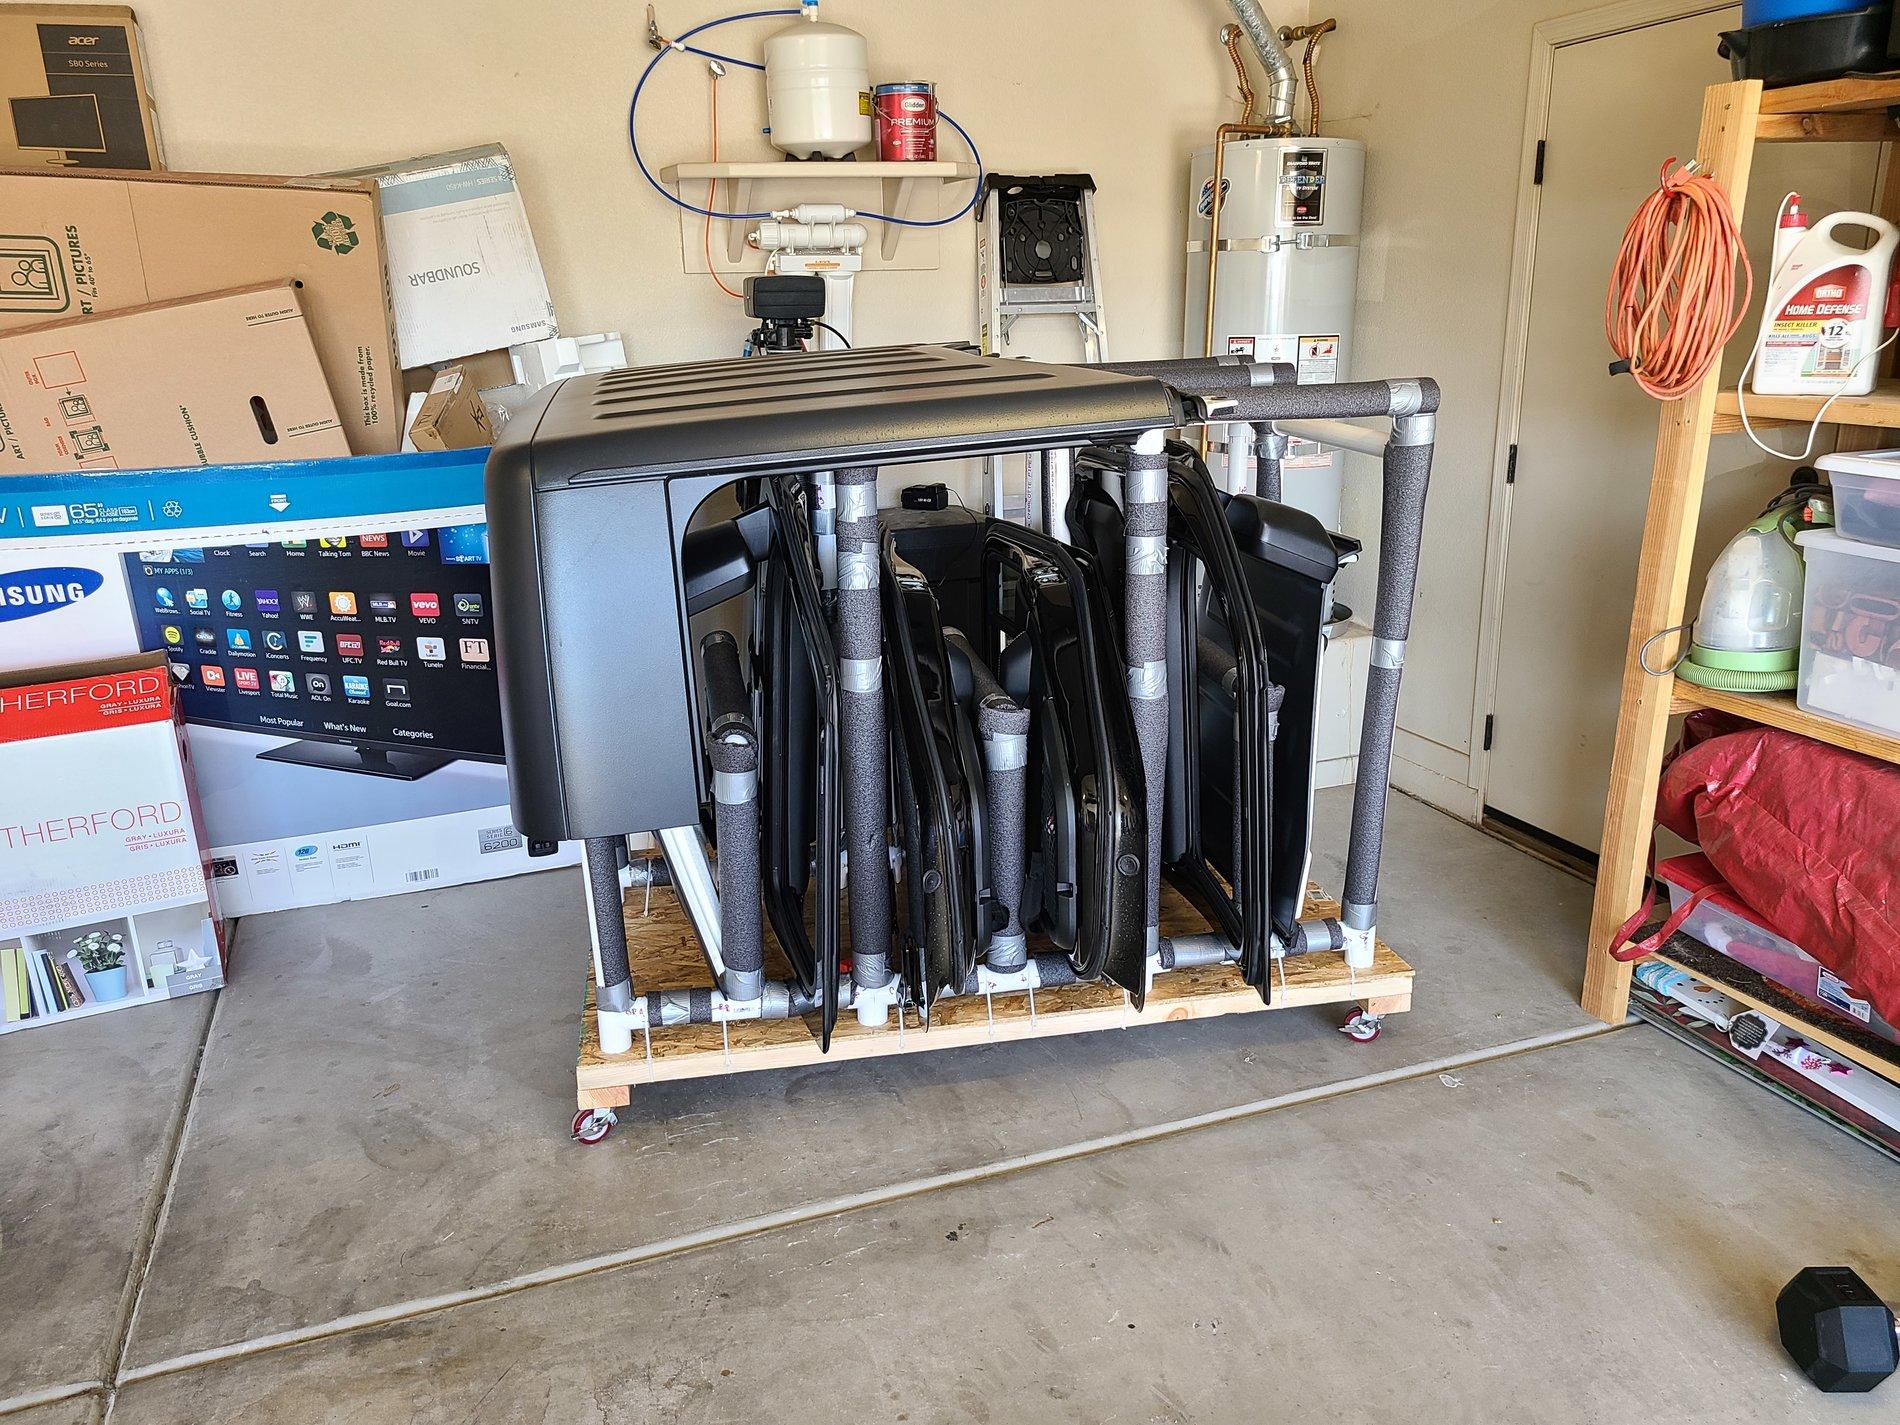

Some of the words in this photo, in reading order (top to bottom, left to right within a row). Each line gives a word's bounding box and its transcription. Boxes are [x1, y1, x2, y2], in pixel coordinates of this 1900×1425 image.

[68, 36, 99, 46] acer
[85, 60, 108, 68] Series
[890, 118, 935, 126] PREMIUM
[1280, 175, 1326, 184] DEFENDER
[65, 224, 88, 285] PICTURES
[408, 261, 481, 288] SOUNDBAR
[80, 300, 94, 314] RT
[1784, 304, 1815, 316] HOME
[1816, 304, 1863, 315] DEFENSE
[511, 320, 547, 334] SAMSUNG
[1829, 326, 1844, 336] 12
[365, 346, 374, 371] paper.
[366, 371, 376, 402] recycled
[11, 444, 26, 460] ART
[70, 503, 103, 518] 65"
[361, 533, 386, 541] NEWS
[180, 568, 194, 576] (1/3)
[412, 601, 438, 610] vevo
[464, 640, 486, 654] FT
[300, 655, 328, 663] Frequency
[100, 701, 123, 709] GRAY
[128, 696, 161, 705] LUXURA
[129, 703, 162, 711] LUXURA
[277, 717, 304, 727] Popular
[323, 721, 349, 732] What's
[351, 725, 367, 733] New
[392, 728, 434, 740] Categories
[0, 801, 181, 848] THERFORD
[125, 834, 147, 843] GRAY
[153, 828, 186, 838] LUXURA
[130, 843, 148, 852] GRIS
[155, 837, 188, 847] LUXURA
[333, 842, 360, 850] HDMI
[484, 838, 518, 850] 6200
